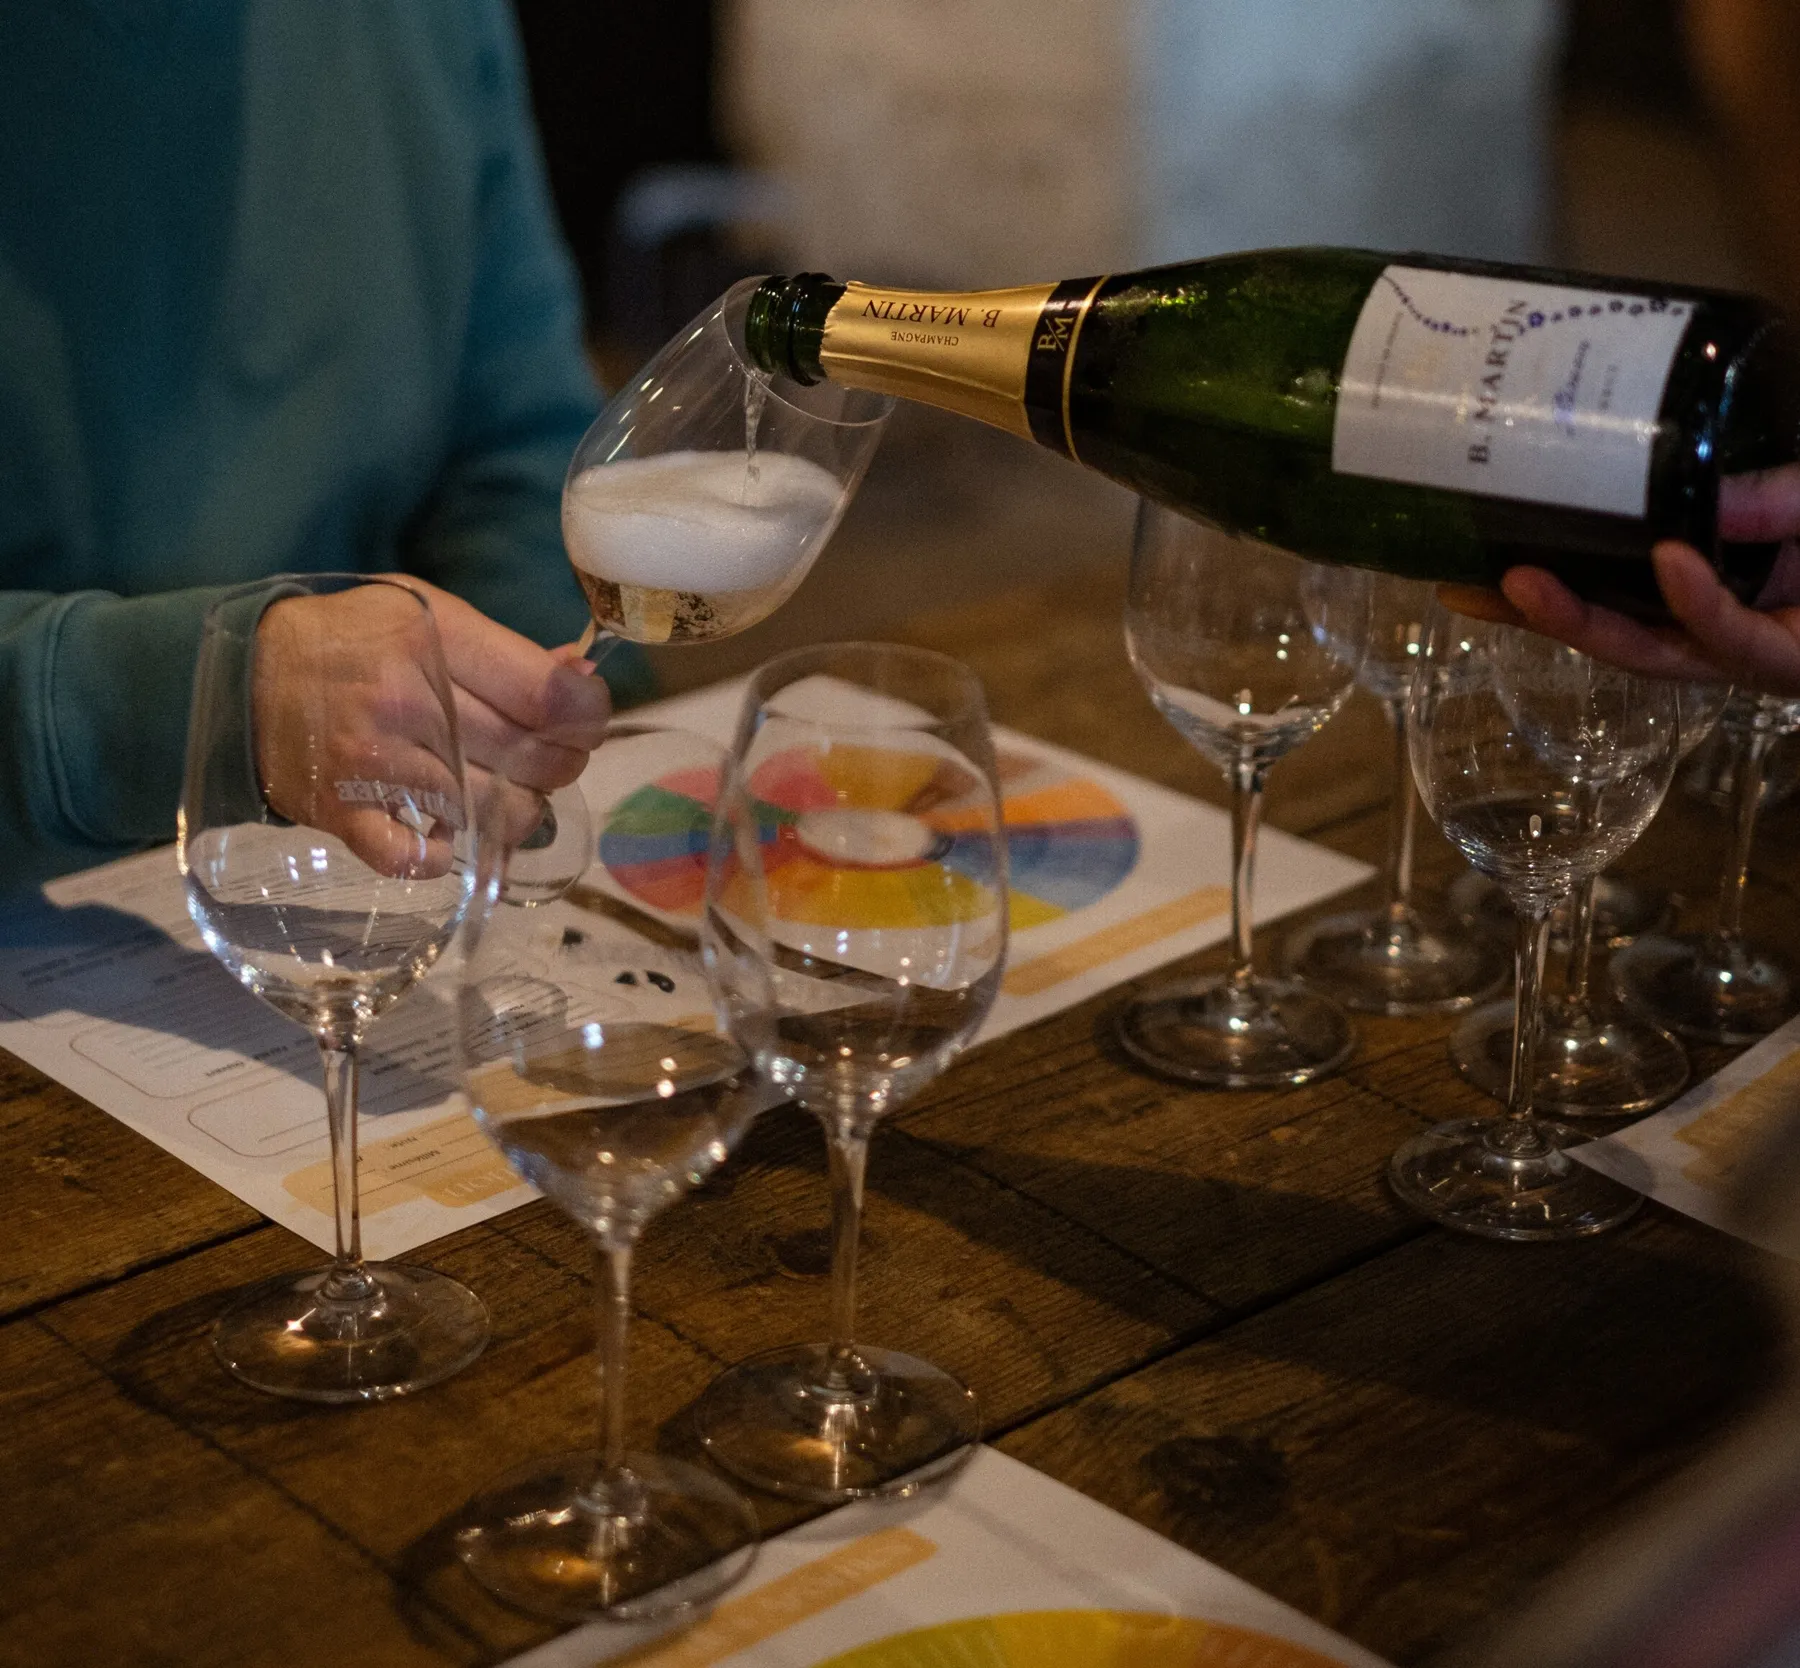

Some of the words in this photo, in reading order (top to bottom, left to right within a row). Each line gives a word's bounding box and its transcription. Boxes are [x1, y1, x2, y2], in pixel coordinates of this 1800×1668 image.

[862, 299, 972, 326] MARTIN
[980, 309, 1002, 328] B.
[891, 331, 959, 346] CHAMPAGNE
[1473, 298, 1528, 423] MARTIN
